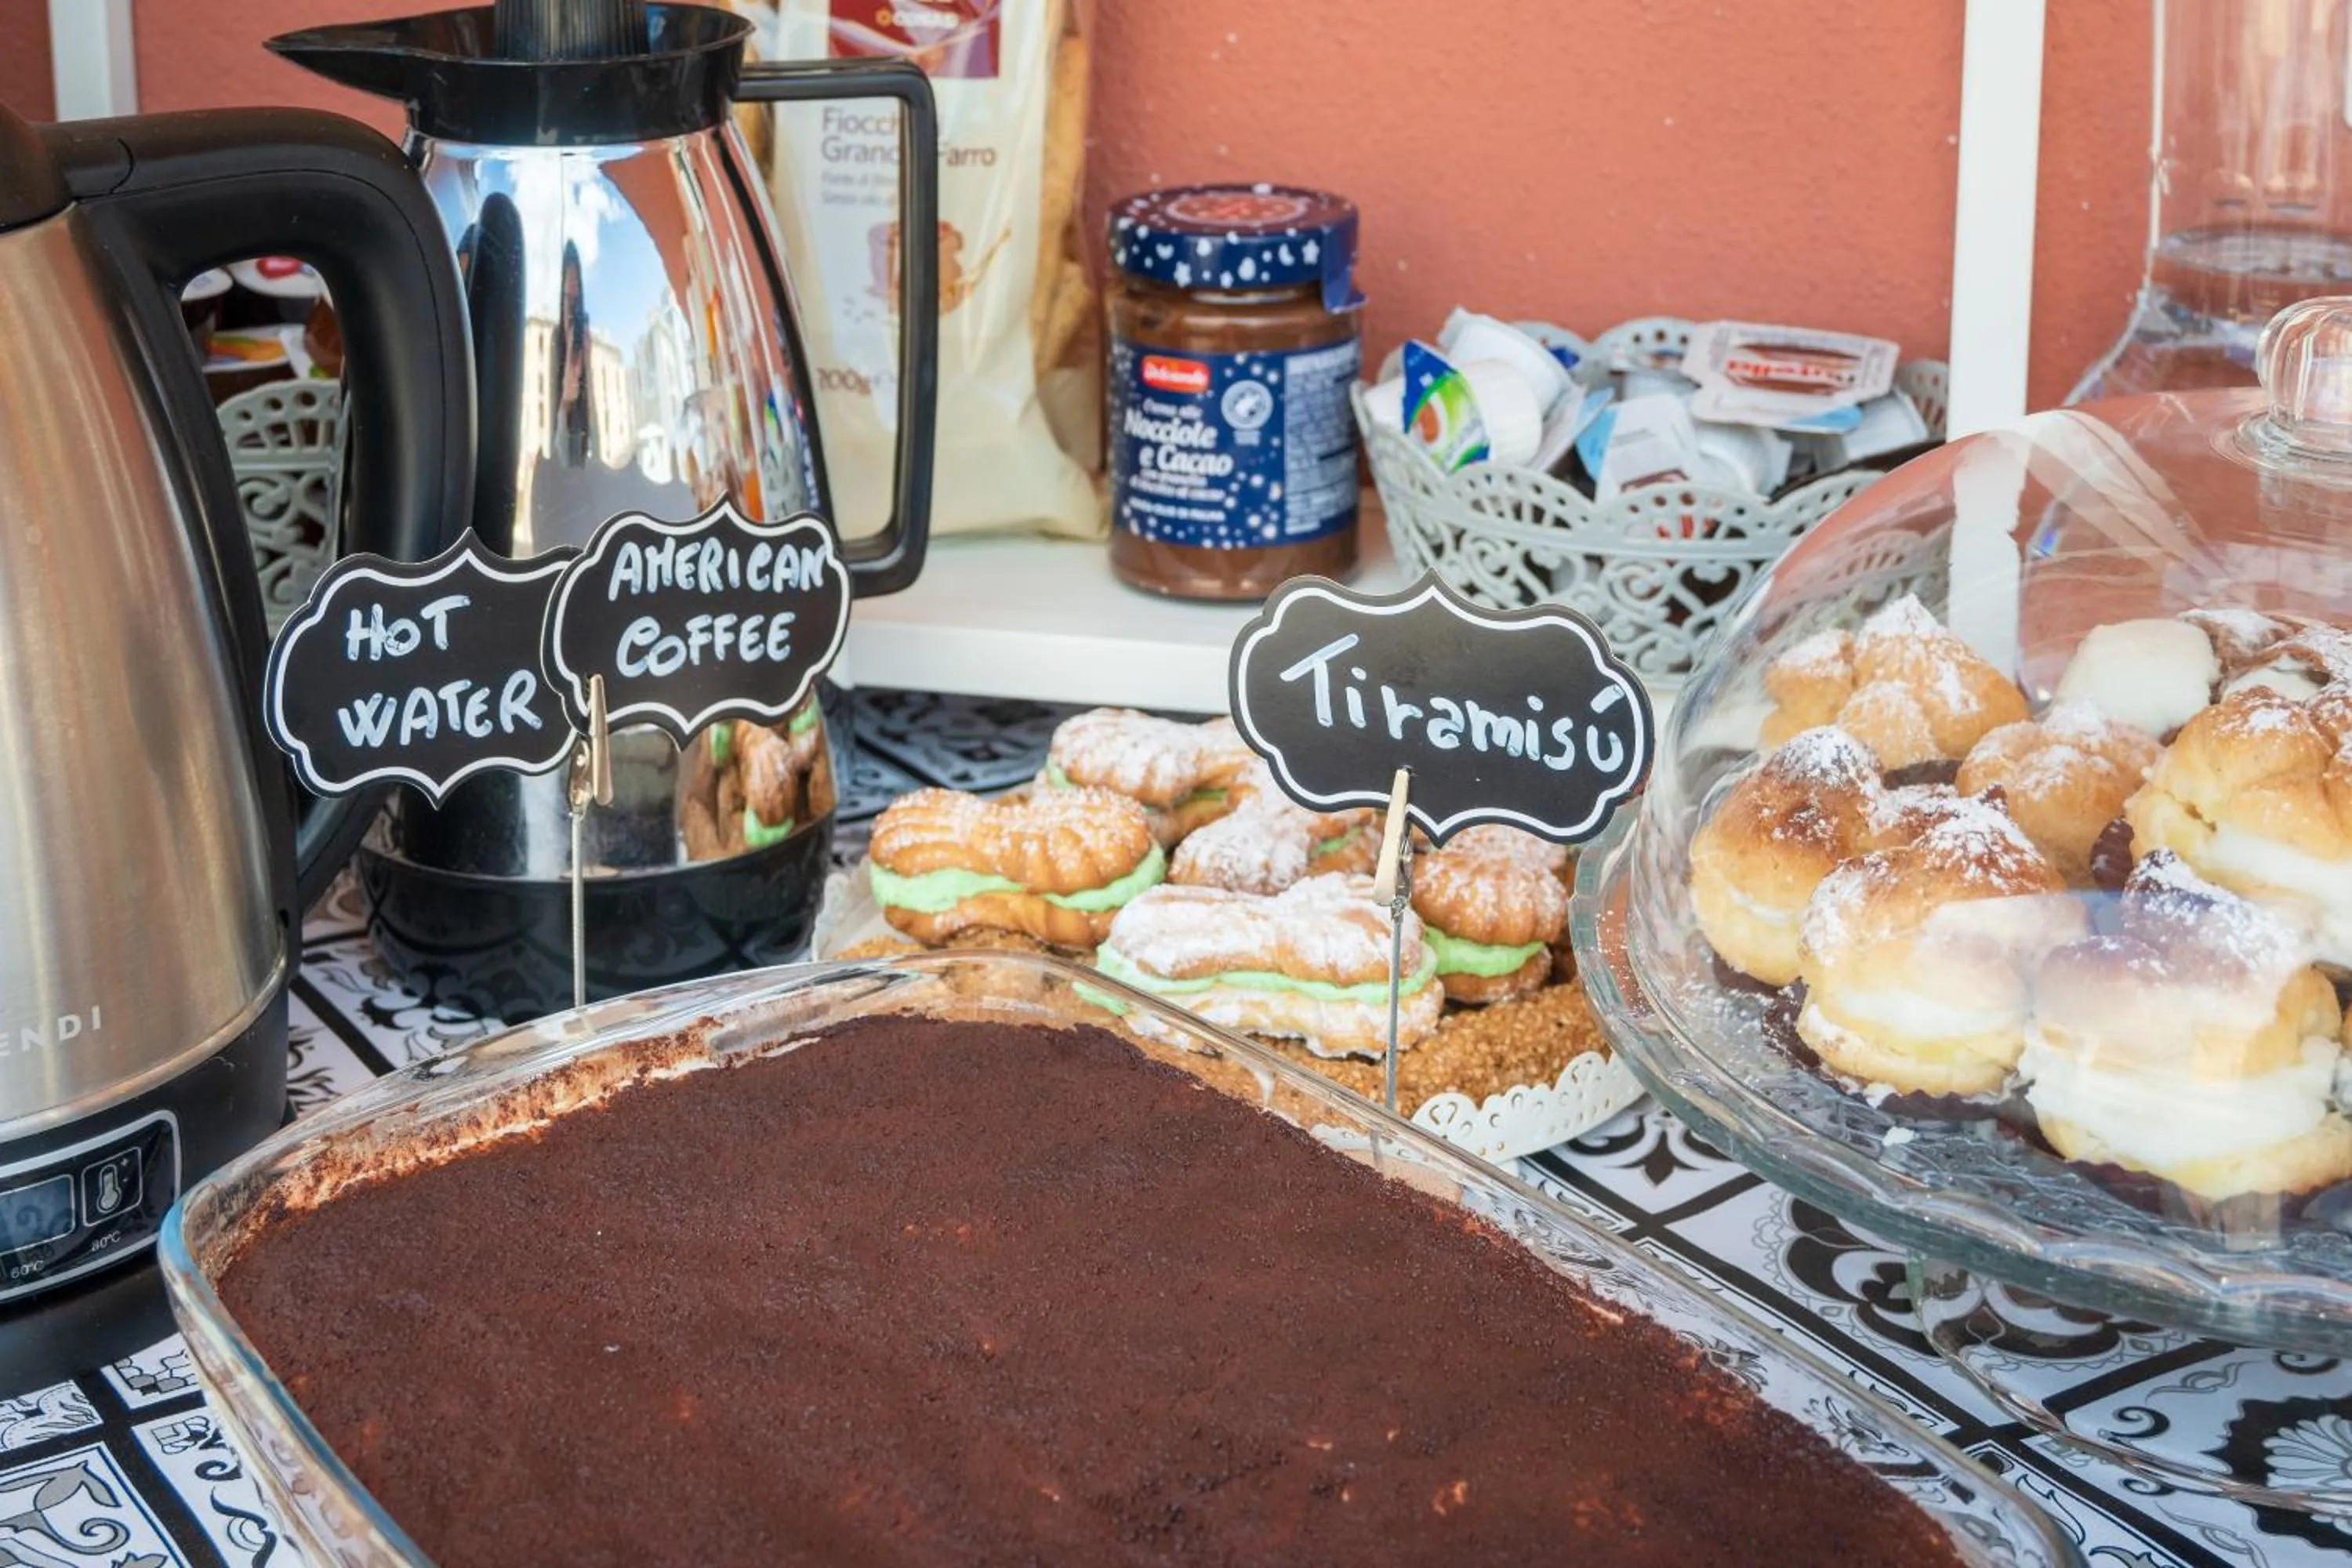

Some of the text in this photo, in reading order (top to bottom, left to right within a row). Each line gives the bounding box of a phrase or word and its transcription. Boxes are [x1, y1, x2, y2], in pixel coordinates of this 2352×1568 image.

[608, 536, 825, 602] AMERICAN
[616, 612, 797, 678] COFFEE
[337, 669, 543, 749] WATER
